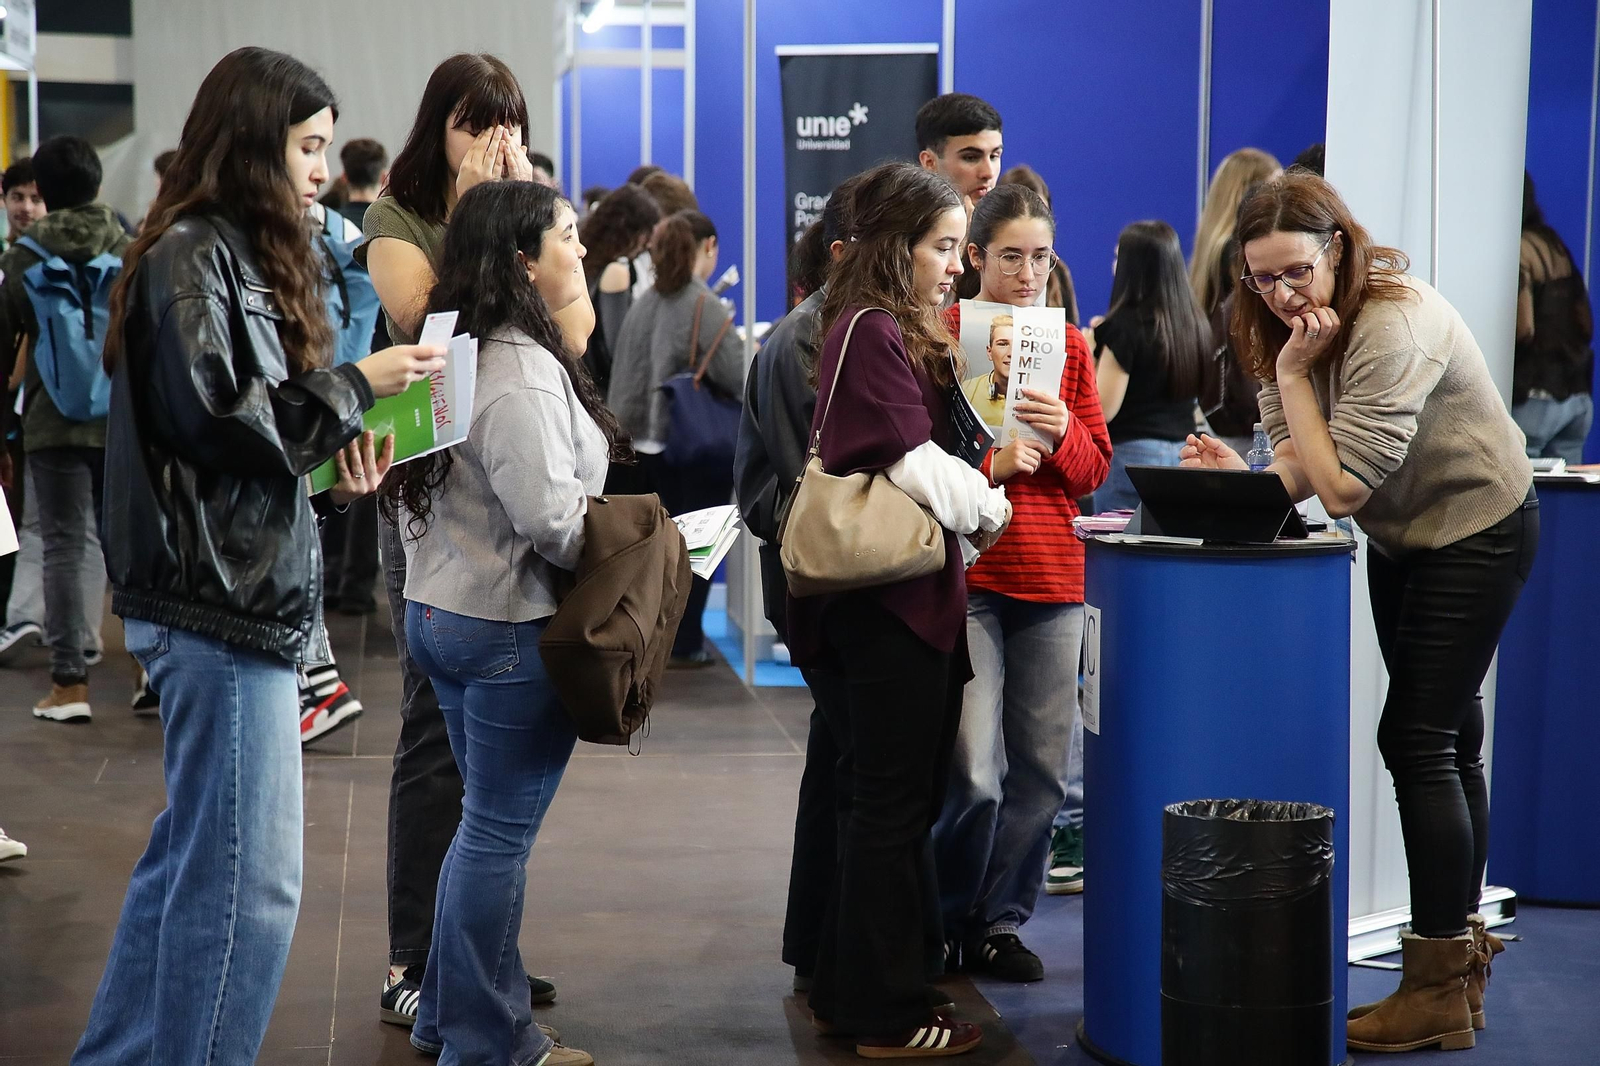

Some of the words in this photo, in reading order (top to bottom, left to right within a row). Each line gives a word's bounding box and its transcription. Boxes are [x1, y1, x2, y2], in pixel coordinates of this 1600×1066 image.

[796, 138, 851, 150] Universidad
[1021, 325, 1059, 339] COM
[1020, 340, 1053, 355] PRO
[1018, 356, 1042, 370] ME
[1017, 372, 1031, 385] TI
